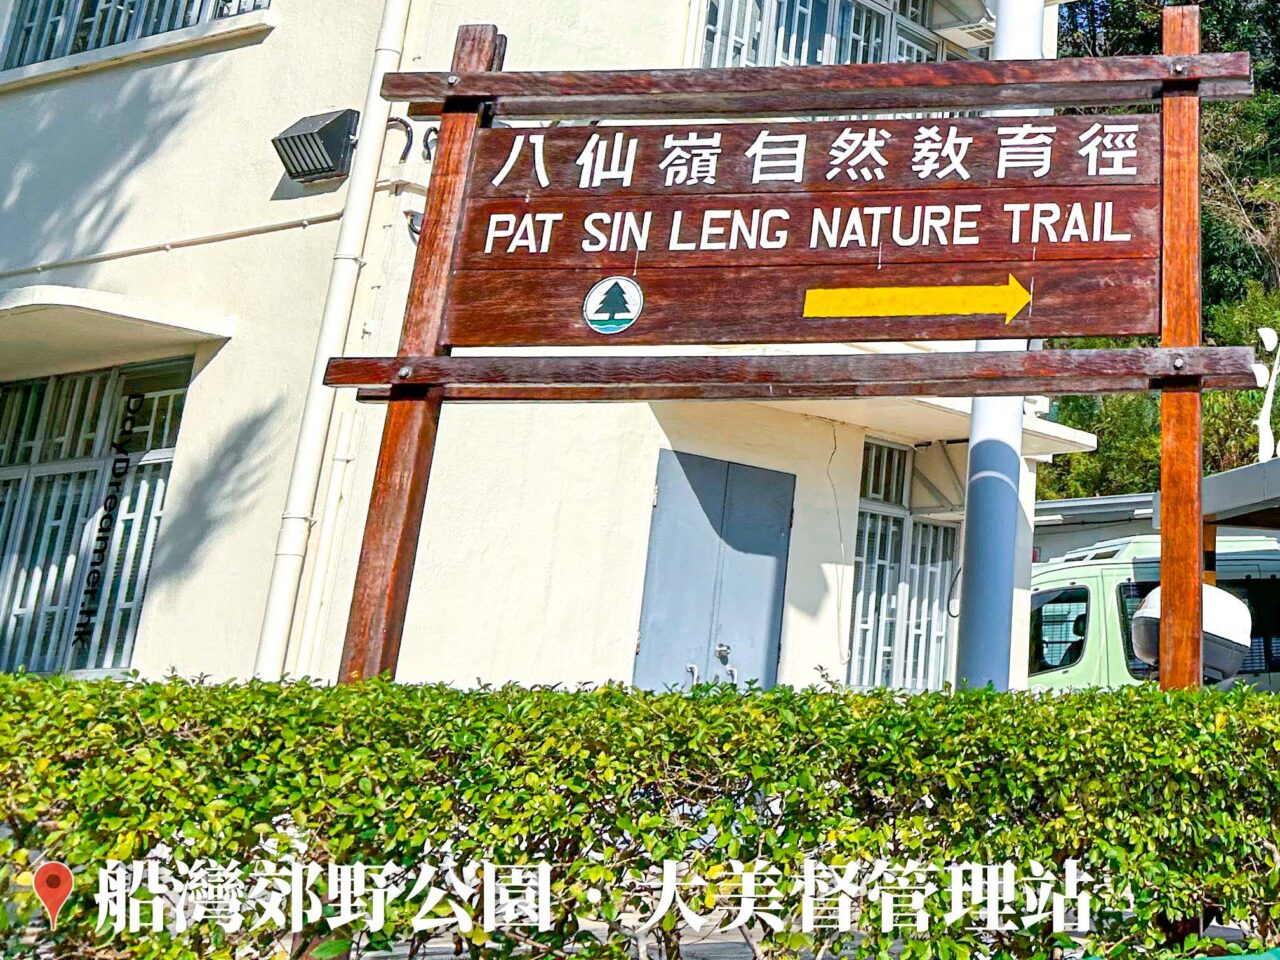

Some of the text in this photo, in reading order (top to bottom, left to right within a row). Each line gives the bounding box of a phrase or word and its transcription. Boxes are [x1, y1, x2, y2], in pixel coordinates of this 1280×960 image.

[484, 201, 1132, 254] PAT SIN LENG NATURE TRAIL
